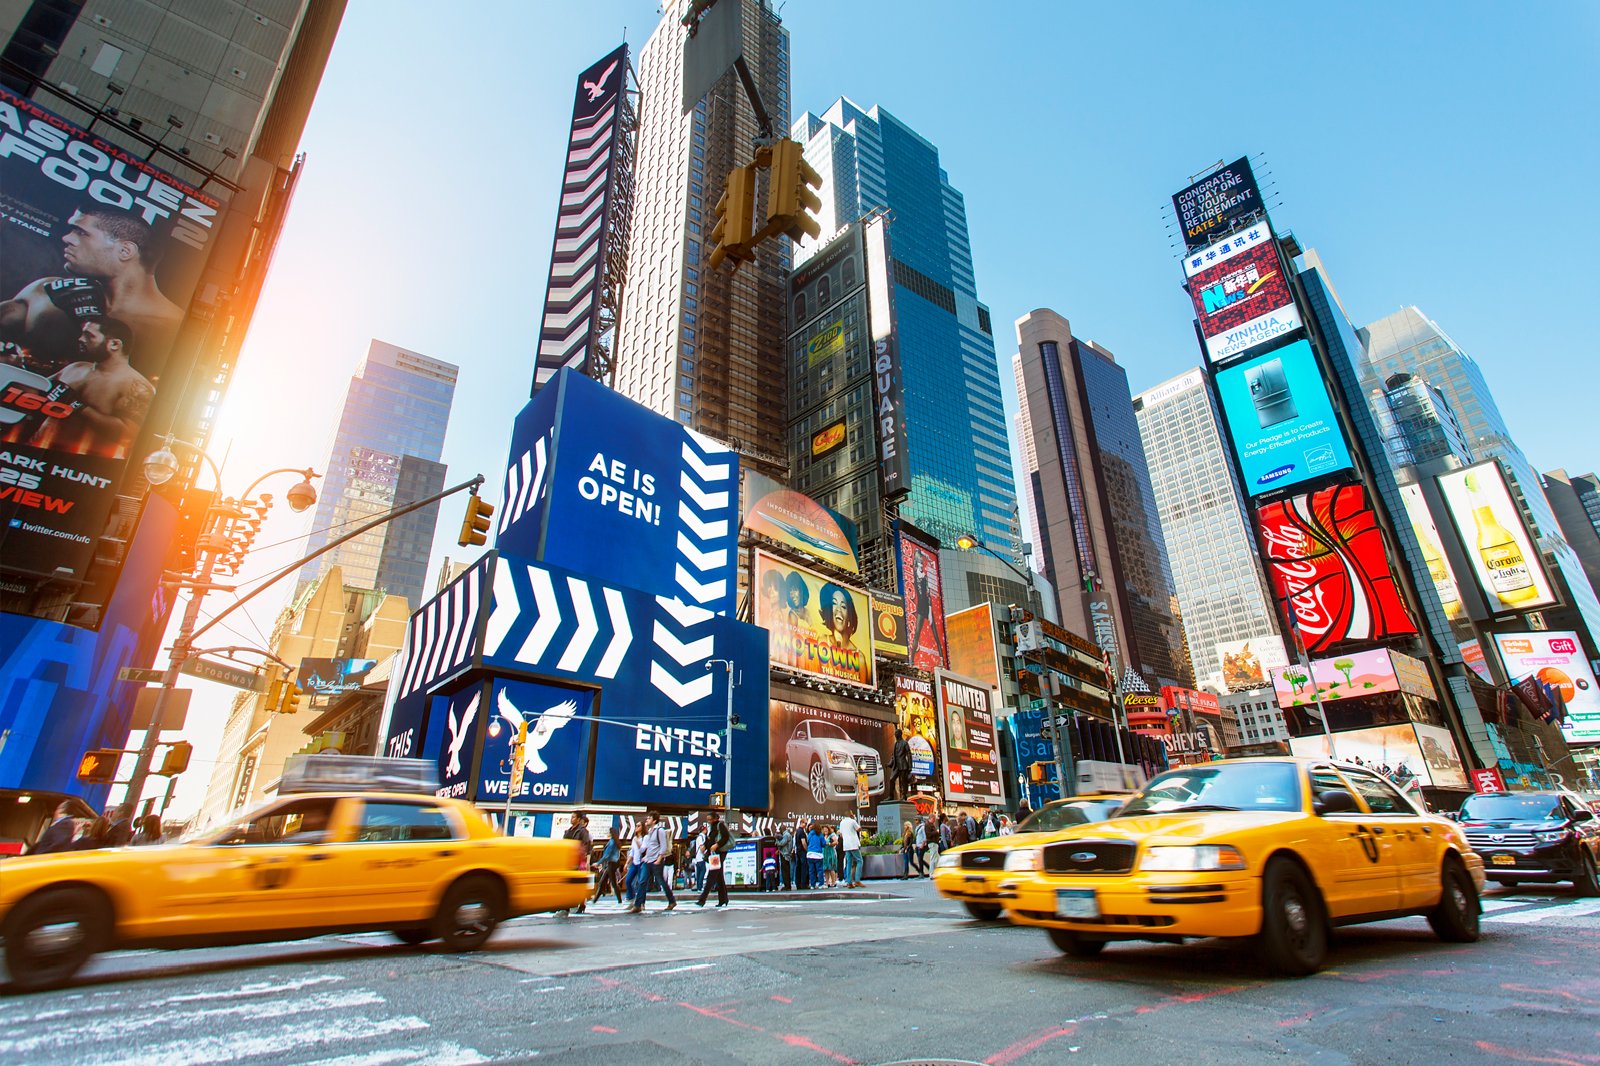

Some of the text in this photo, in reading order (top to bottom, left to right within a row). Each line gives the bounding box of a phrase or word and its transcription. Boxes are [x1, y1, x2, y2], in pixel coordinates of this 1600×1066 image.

[1178, 170, 1233, 204] CONGRATS
[1181, 174, 1243, 212] ON DAY ONE
[1183, 192, 1228, 220] OF YOUR
[1185, 188, 1253, 229] RETIREMENT.
[9, 215, 52, 237] STAKES
[1187, 218, 1215, 238] KATE
[807, 262, 825, 277] TIMES
[826, 241, 850, 263] SQUARE
[1191, 229, 1261, 269] 新华通讯社
[51, 277, 88, 290] UFC
[75, 305, 99, 315] UFC
[1217, 320, 1294, 357] NEWS AGENCY
[1225, 316, 1280, 345] XINHUA
[3, 386, 74, 419] 160
[874, 337, 897, 461] SQUARE
[1150, 383, 1180, 402] Allianz
[1245, 440, 1258, 450] Our
[1259, 433, 1283, 446] Pledge
[1299, 420, 1324, 432] Create
[1297, 426, 1331, 441] Products
[50, 464, 112, 490] HUNT
[588, 452, 656, 496] AE IS
[885, 472, 898, 483] NYC
[1261, 467, 1292, 482] SAMSUNG
[578, 476, 661, 527] OPEN!
[767, 501, 798, 520] IMPORTED
[799, 516, 815, 528] FROM
[22, 521, 91, 544] twitter.com/ufc
[1486, 555, 1523, 570] Corona
[871, 596, 905, 617] Avenue
[877, 611, 897, 641] Q
[772, 631, 861, 673] MOTOWN
[1550, 641, 1573, 651] Gift
[134, 670, 143, 679] 7
[195, 663, 255, 686] Broadway
[821, 665, 861, 682] THE MUSICAL
[902, 680, 914, 691] JOY
[945, 680, 987, 712] WANTED
[1124, 693, 1158, 706] Reese's
[784, 704, 818, 716] CHRYSLER
[833, 713, 859, 724] MOTOWN
[860, 716, 882, 728] EDITION
[389, 728, 414, 761] THIS
[635, 723, 721, 758] ENTER
[642, 759, 712, 789] HERE
[1477, 771, 1499, 793] tkt
[451, 781, 468, 798] OPEN
[533, 782, 569, 797] OPEN
